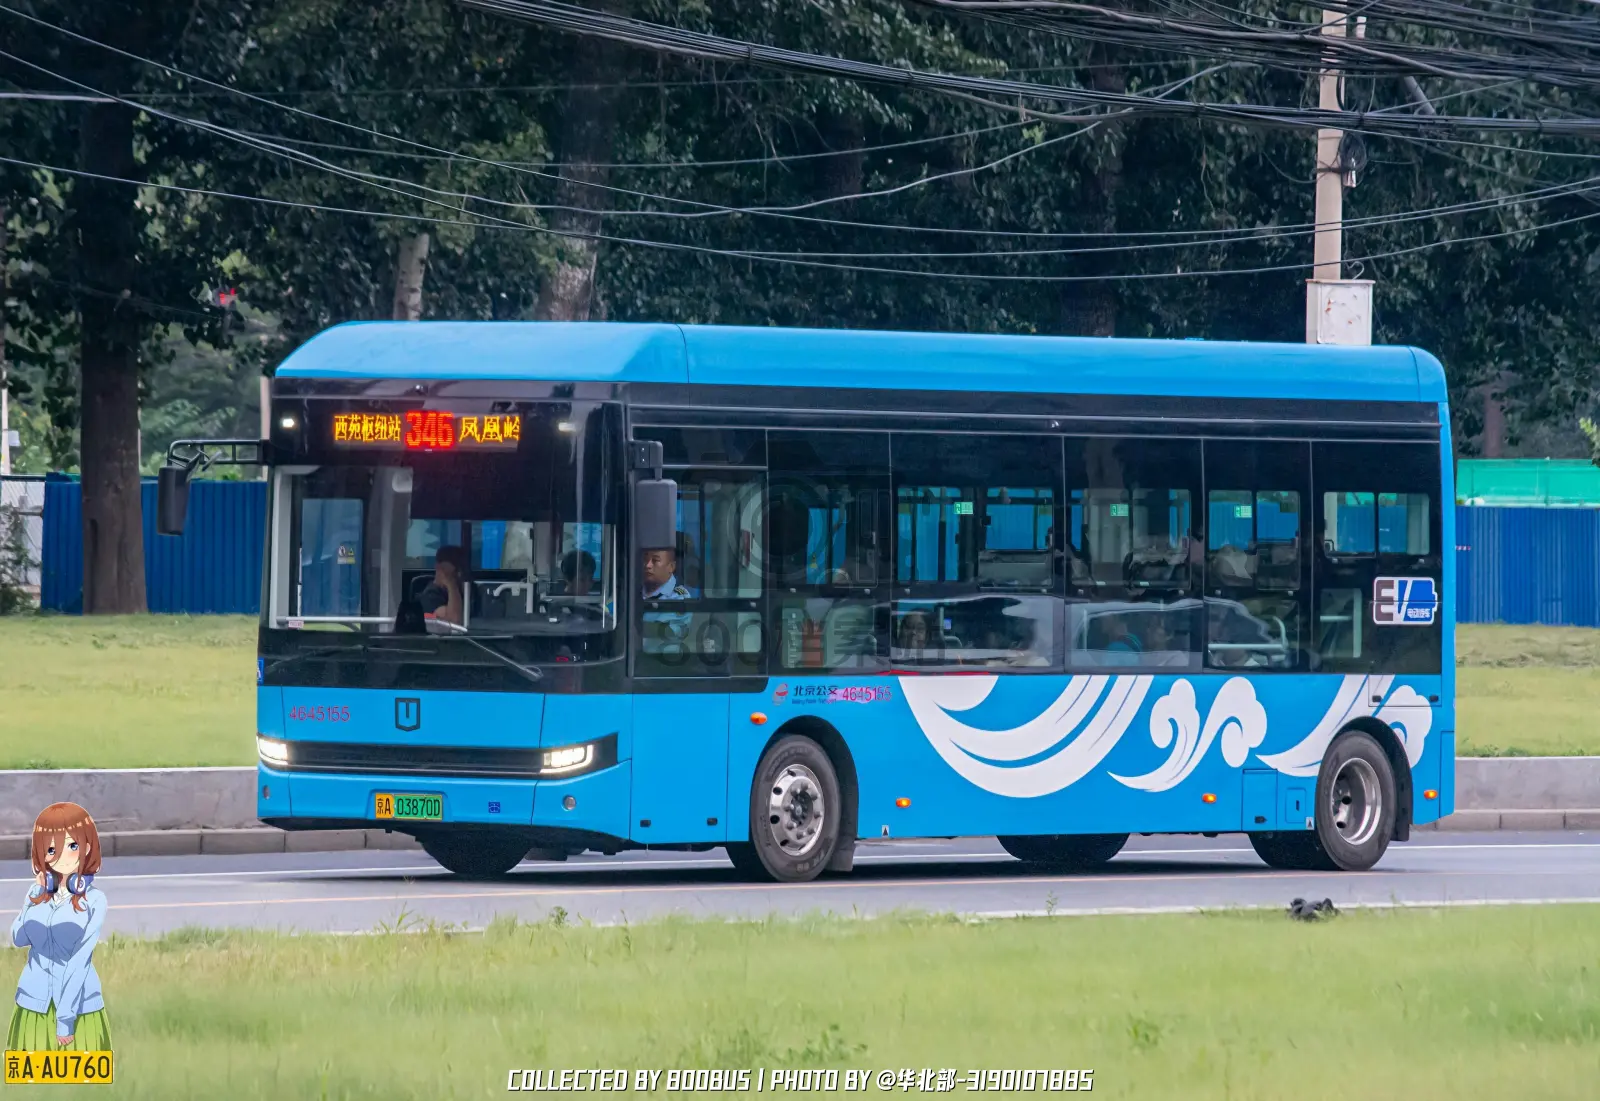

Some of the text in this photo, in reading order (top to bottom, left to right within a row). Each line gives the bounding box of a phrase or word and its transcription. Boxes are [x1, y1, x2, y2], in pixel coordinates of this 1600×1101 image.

[334, 414, 401, 442] 西苑枢纽站
[405, 411, 454, 448] 346
[793, 685, 839, 697] 北京公交
[842, 686, 892, 702] 4645155
[289, 705, 350, 722] 4645155
